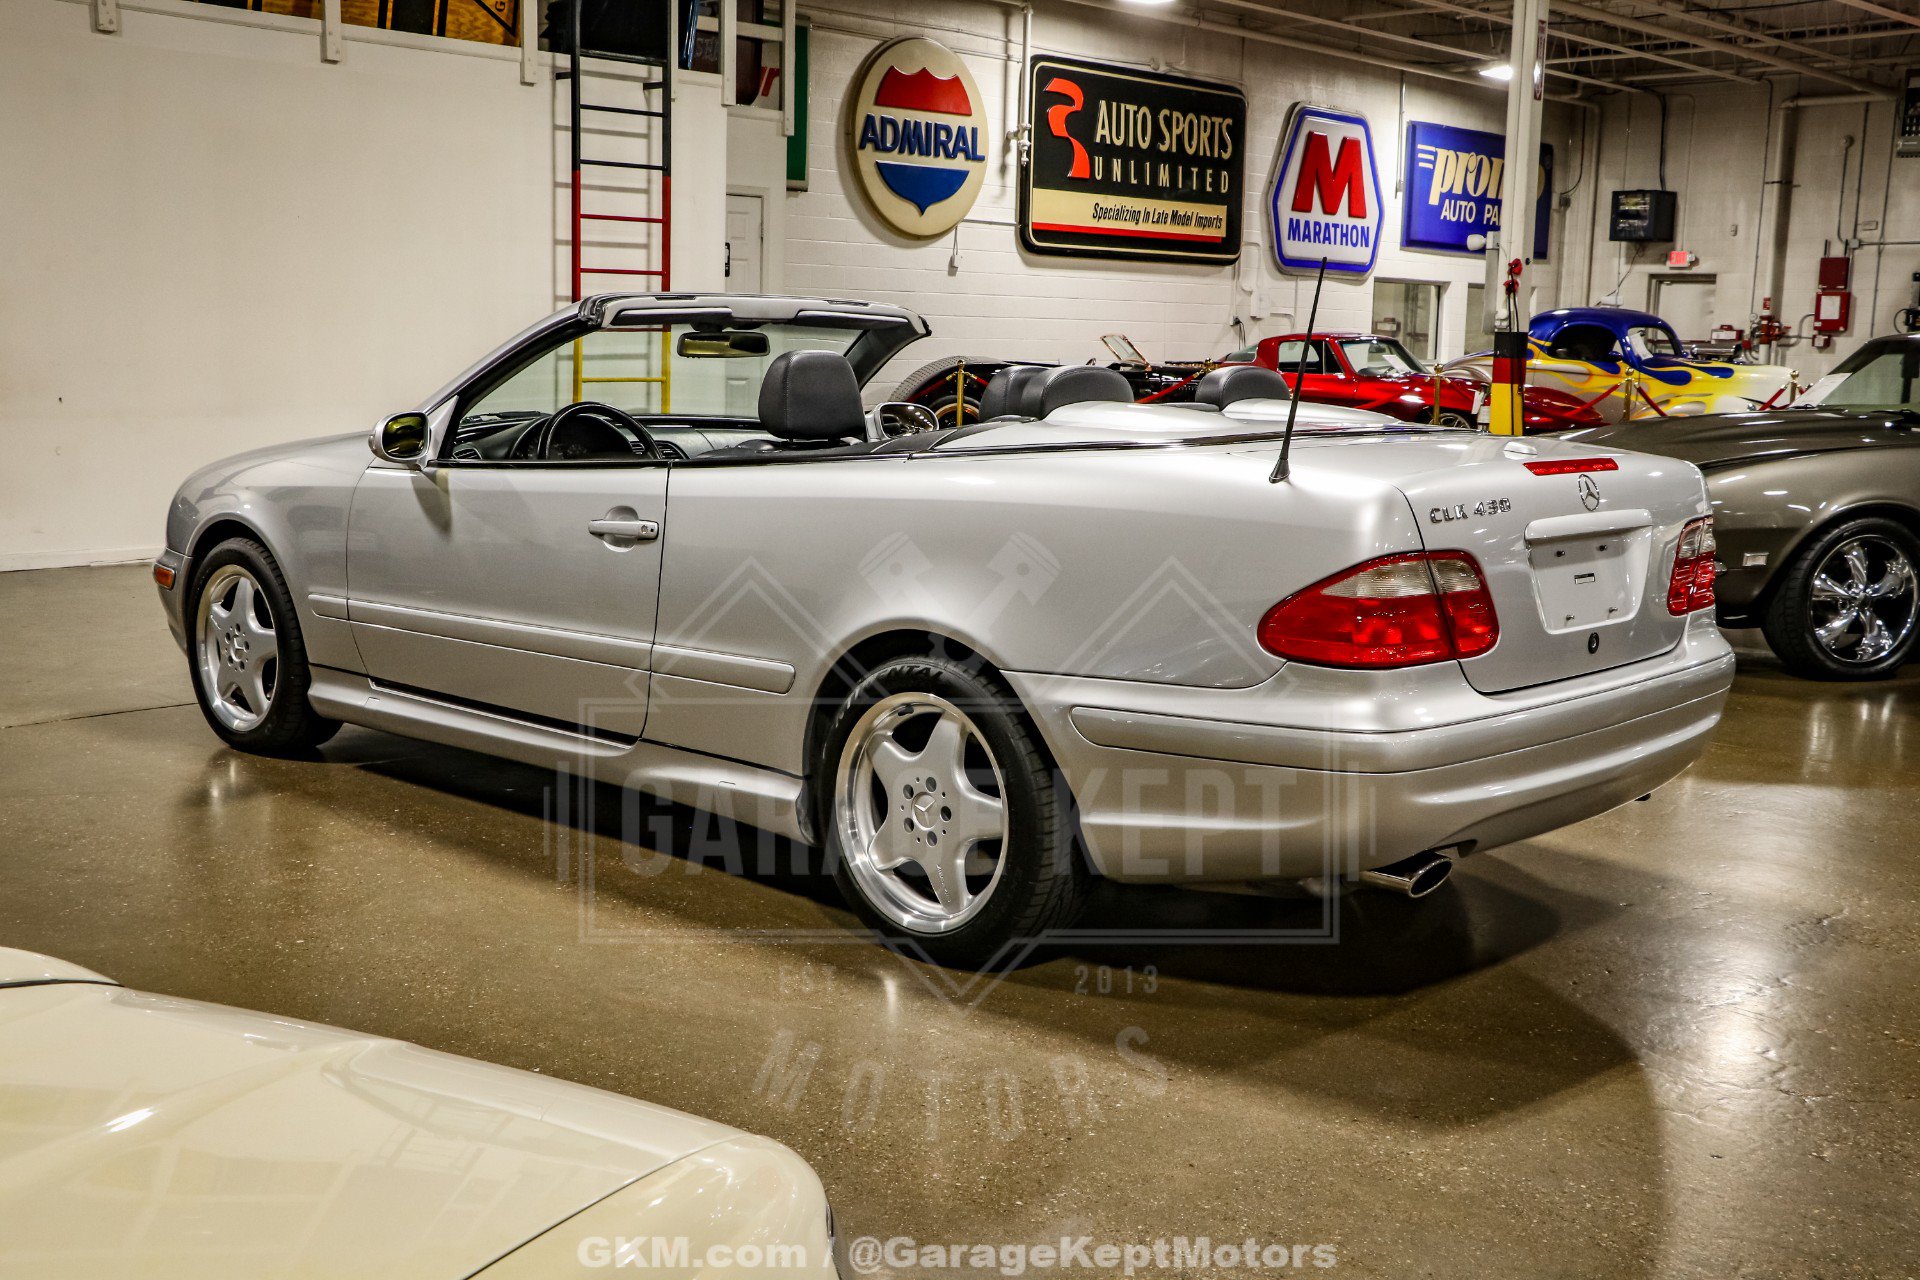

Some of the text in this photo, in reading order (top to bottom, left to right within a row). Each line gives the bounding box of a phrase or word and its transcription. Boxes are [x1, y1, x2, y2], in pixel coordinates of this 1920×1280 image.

[859, 113, 985, 161] ADMIRAL
[1095, 100, 1233, 160] AUTO SPORTS
[1094, 156, 1229, 193] UNLIMITED
[1291, 130, 1367, 219] M
[1092, 202, 1223, 230] Specializing In Late Model Imports
[1440, 199, 1501, 226] AUTO PA
[1287, 218, 1370, 247] MARATHON
[1429, 498, 1511, 523] CLK 430
